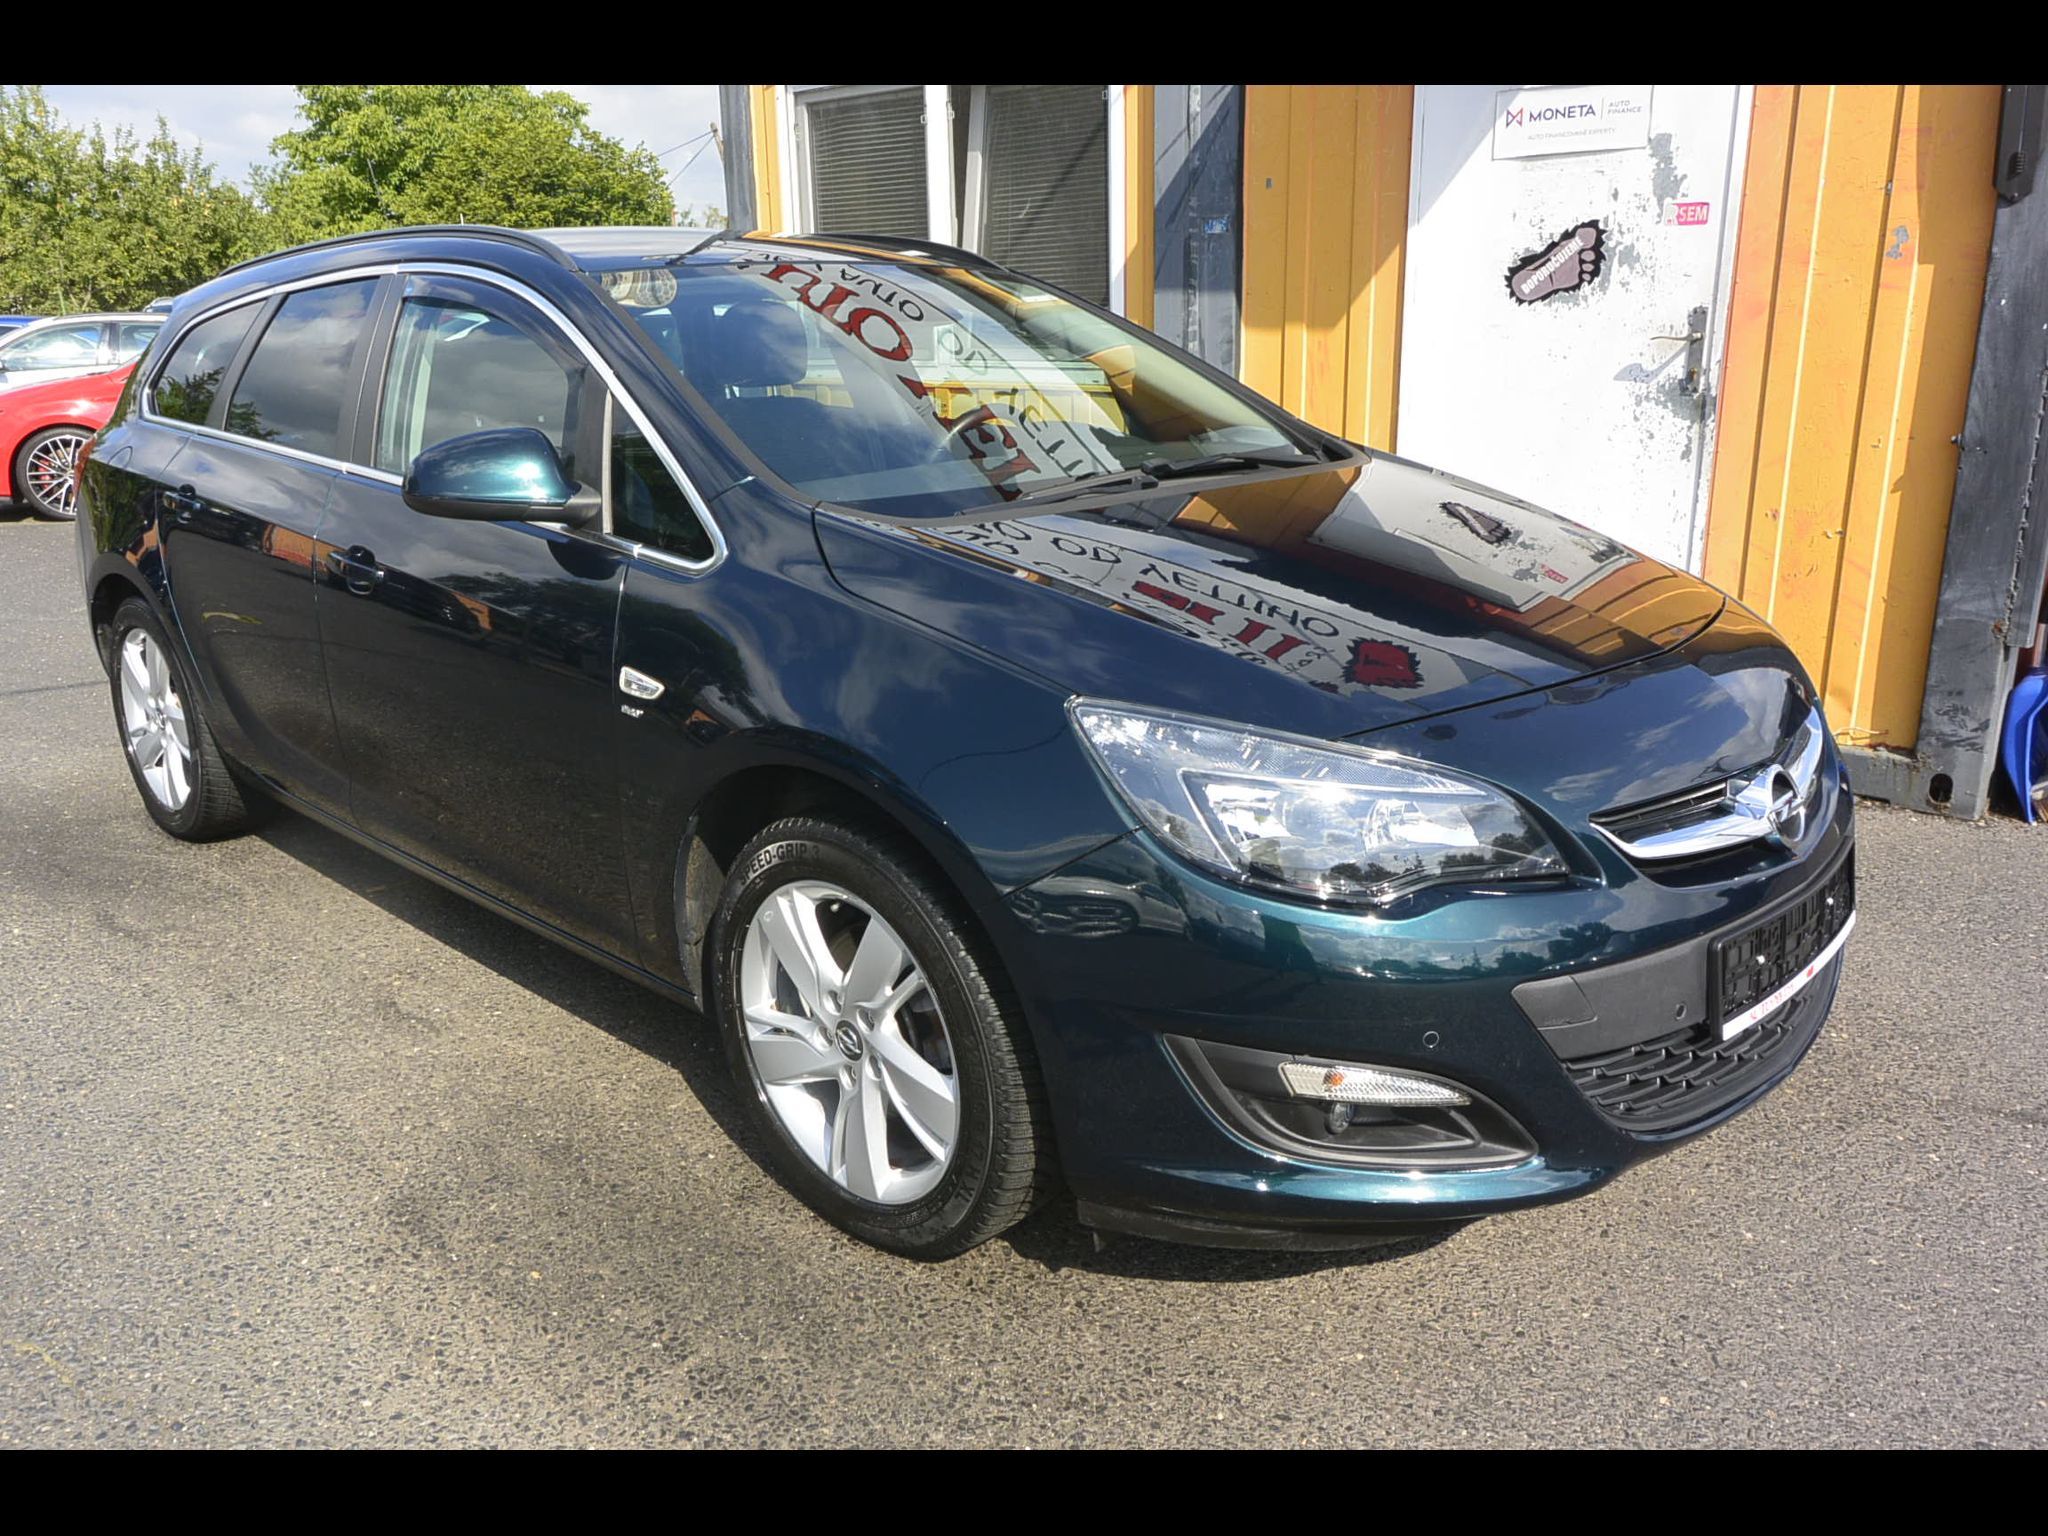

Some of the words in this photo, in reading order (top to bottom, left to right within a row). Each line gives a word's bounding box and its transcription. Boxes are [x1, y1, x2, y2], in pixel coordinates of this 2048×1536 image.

[1607, 106, 1642, 114] FINANCE
[1608, 100, 1631, 108] AUTO
[1529, 104, 1596, 122] MONETA
[1679, 204, 1708, 222] SEM
